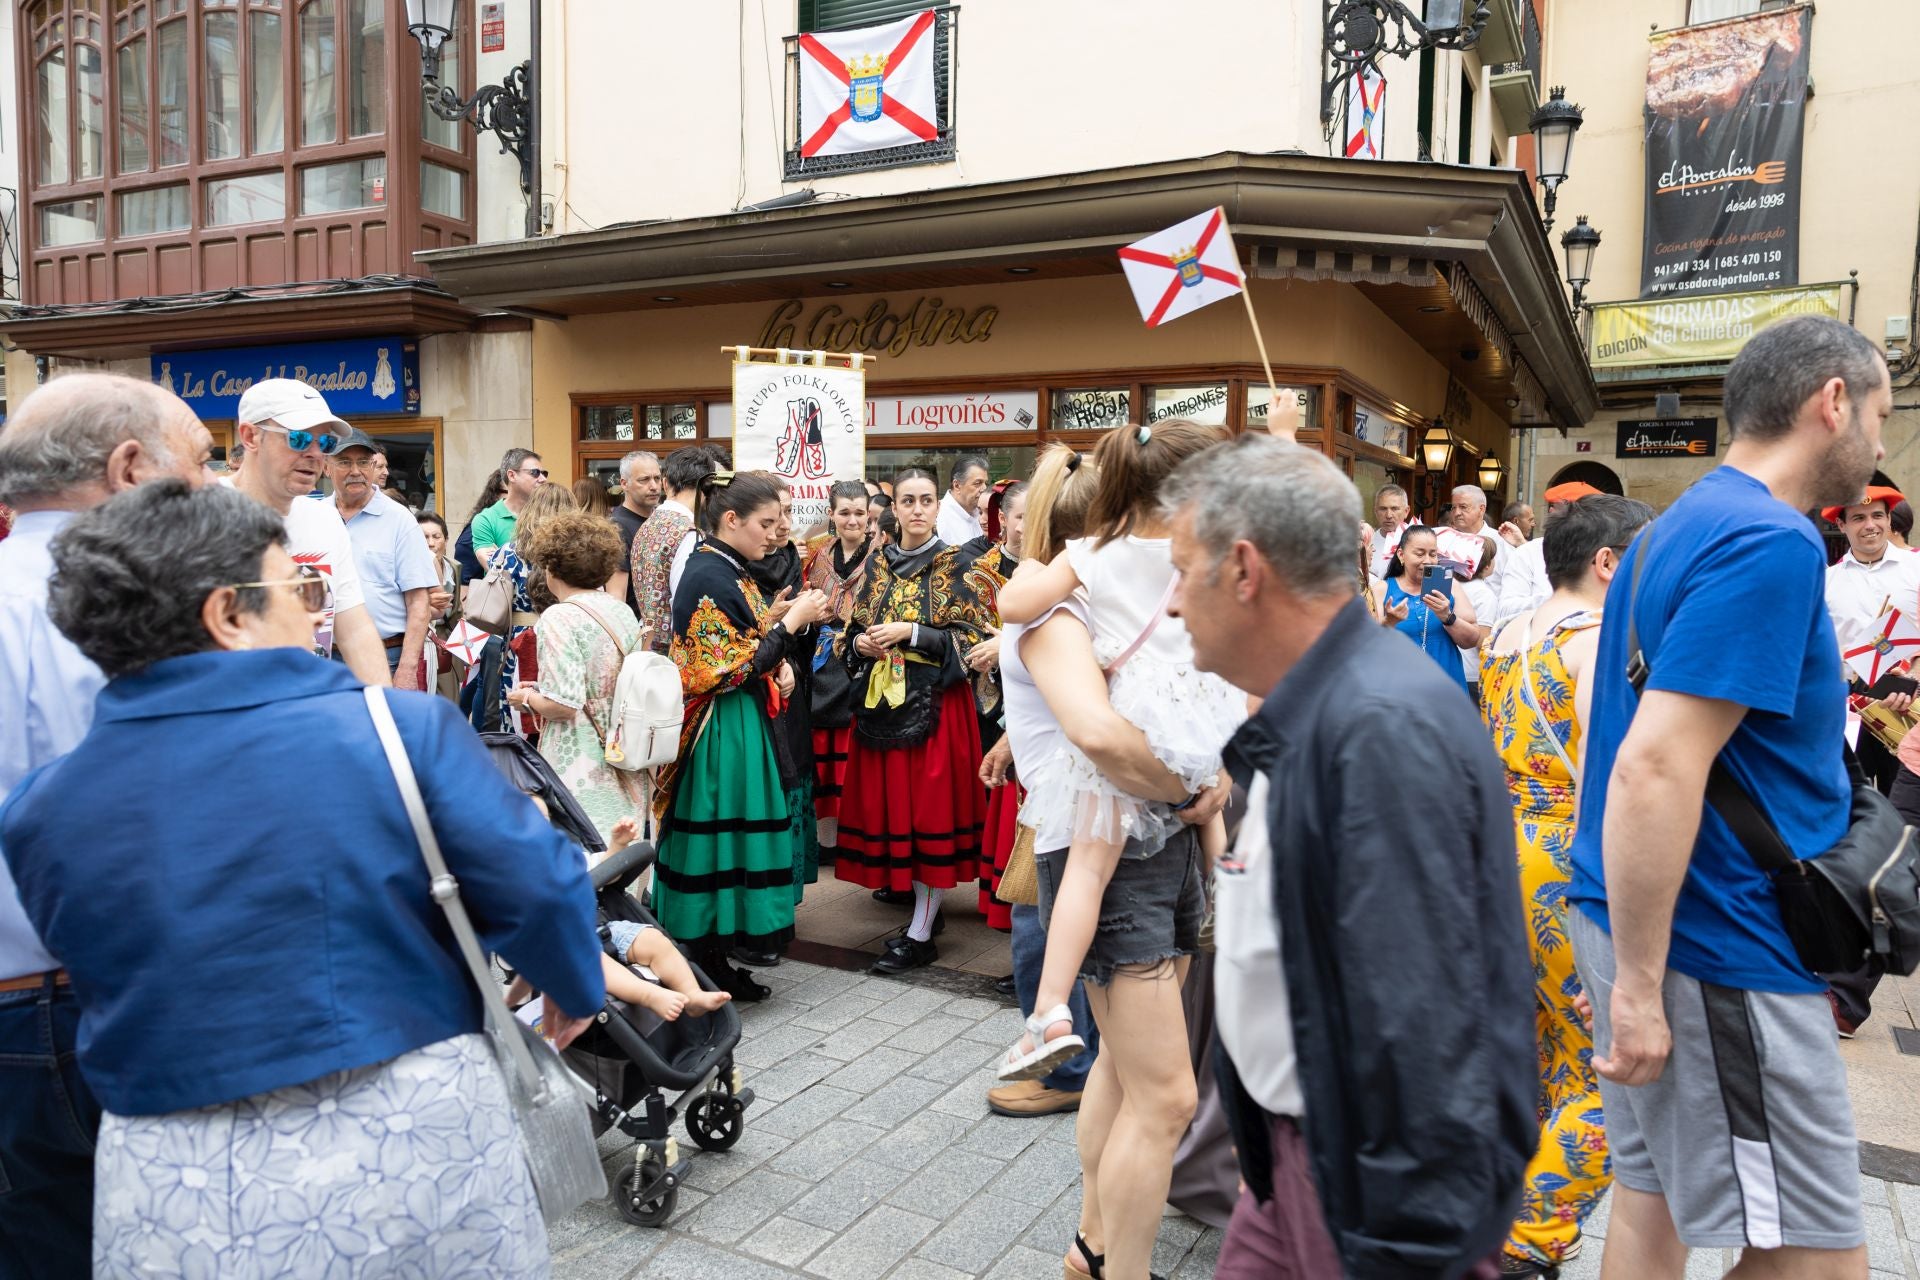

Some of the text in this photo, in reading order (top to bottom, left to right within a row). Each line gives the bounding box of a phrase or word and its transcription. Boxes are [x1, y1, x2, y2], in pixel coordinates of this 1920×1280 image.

[1658, 149, 1755, 196] El Portalón
[1725, 193, 1785, 213] desde 1998
[1725, 232, 1738, 245] de
[1740, 226, 1785, 243] mercado
[1654, 250, 1781, 277] 941 241 334 685 470 150
[1651, 270, 1781, 292] www.asadorelportalon.es
[1653, 297, 1756, 325] JORNADAS
[1597, 332, 1648, 359] EDICIÓN
[1654, 319, 1753, 345] del chuletón
[181, 372, 205, 398] La
[210, 370, 252, 397] Casa
[745, 374, 855, 434] GRUPO FOLKLORICO
[896, 394, 1005, 431] Logroñés
[1148, 386, 1226, 424] BOMBONES
[1640, 429, 1688, 455] Portalón
